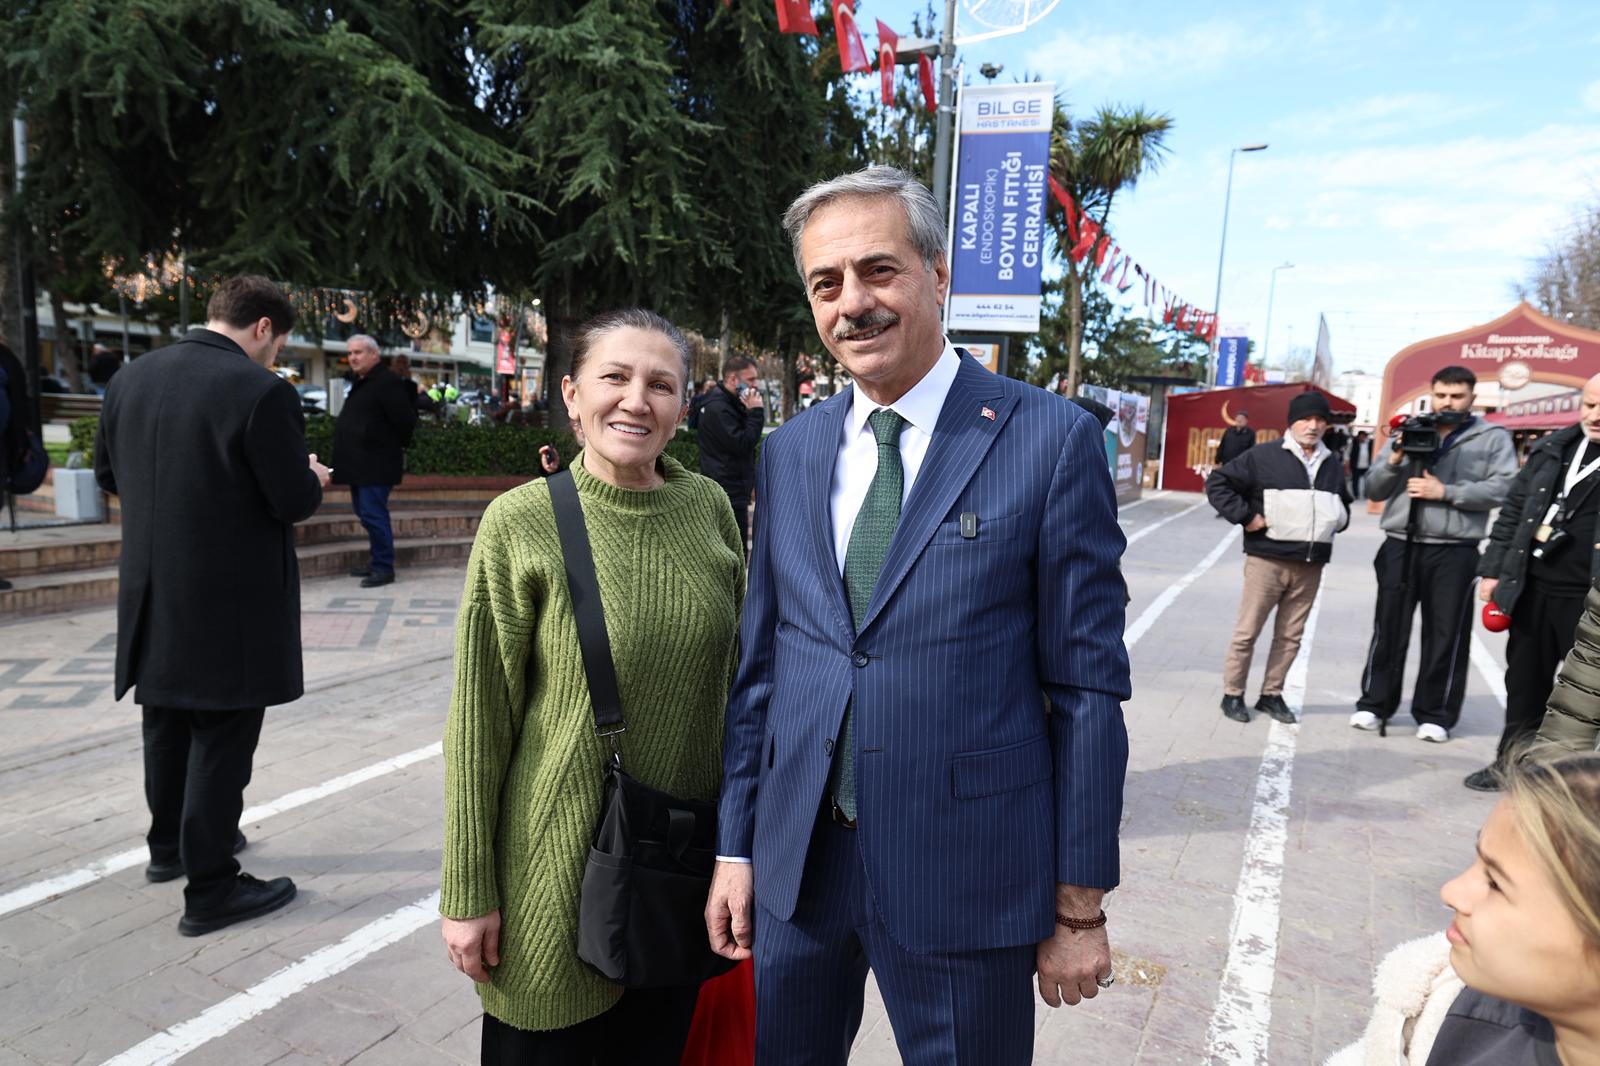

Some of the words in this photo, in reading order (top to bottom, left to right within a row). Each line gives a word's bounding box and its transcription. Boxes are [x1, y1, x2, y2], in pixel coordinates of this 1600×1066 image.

[1001, 151, 1022, 207] FITIĞI
[961, 184, 980, 249] KAPALI
[980, 168, 999, 265] (ENDOSKOPİK)
[998, 212, 1018, 280] BOYUN
[1022, 165, 1045, 268] CERRAHİSİ
[1461, 344, 1511, 362] Kitap
[1512, 344, 1578, 361] Sokağı
